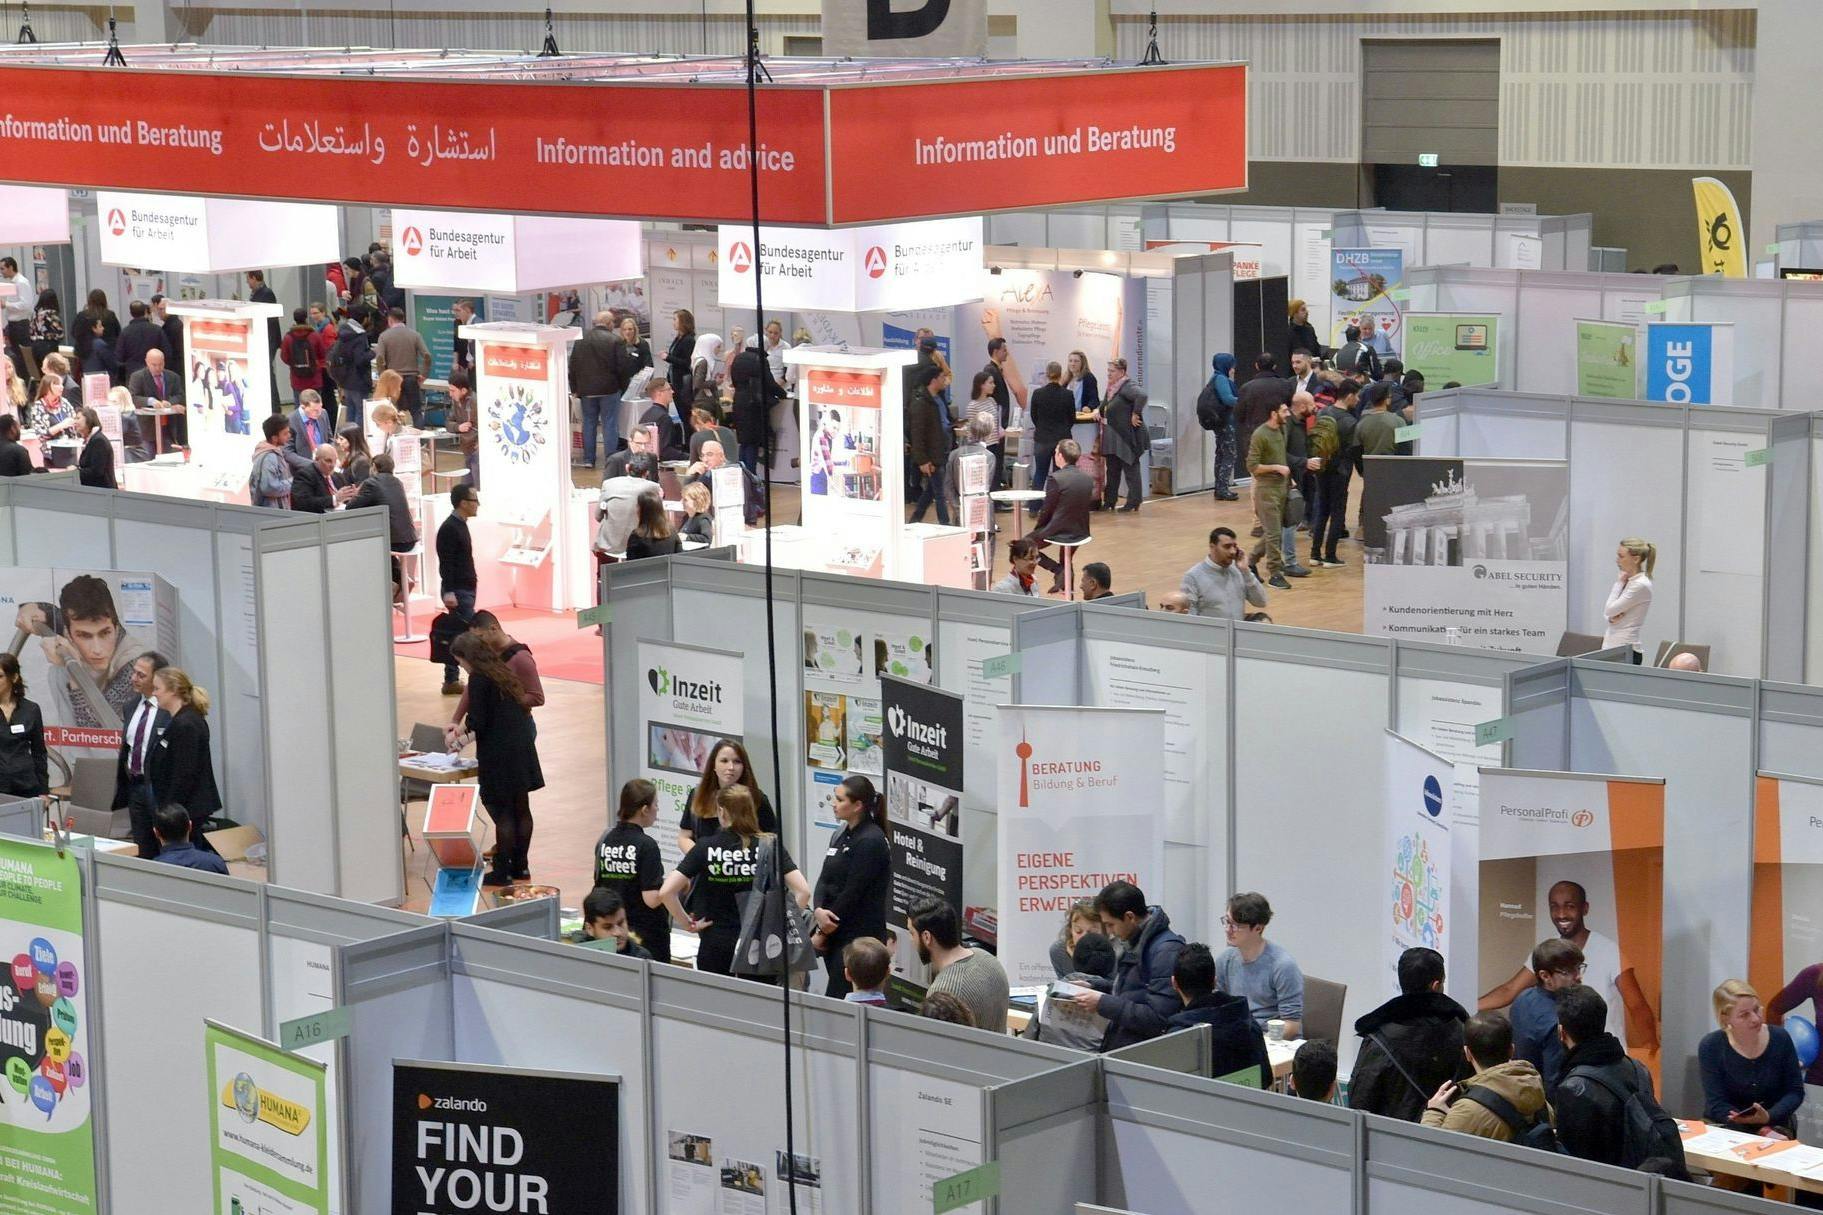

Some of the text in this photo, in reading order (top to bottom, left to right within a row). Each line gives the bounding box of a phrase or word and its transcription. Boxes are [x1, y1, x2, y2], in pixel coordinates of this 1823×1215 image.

[98, 120, 132, 144] und
[137, 120, 223, 155] Beratung
[258, 118, 496, 167] استشارة واستعلامات
[915, 125, 1176, 165] Information und Beratung
[537, 137, 795, 171] Information and advice
[131, 210, 198, 227] Bundesagentur
[132, 226, 174, 240] für Arbeit
[429, 228, 505, 246] Bundesagentur
[430, 245, 477, 260] für Arbeit
[759, 243, 844, 263] Bundesagentur
[1336, 253, 1369, 263] DHZB
[760, 264, 813, 278] für Arbeit
[1488, 572, 1562, 581] ABEL SECURITY
[1388, 605, 1513, 617] Kundenorientierung mit Herz
[1388, 624, 1447, 633] Kommunikati
[1474, 626, 1488, 634] ein
[1489, 628, 1520, 636] starkes
[1522, 628, 1546, 637] Team
[672, 675, 722, 703] Inzeit
[672, 700, 713, 715] Gute Arbeit
[61, 729, 122, 745] Partnersch
[906, 715, 947, 749] Inzeit
[906, 741, 940, 760] Gute Arbeit
[1032, 760, 1101, 775] BERATUNG
[1033, 775, 1119, 790] Bildung & Beruf
[1500, 804, 1569, 819] PersonalProfi
[893, 829, 924, 853] Hotel &
[625, 844, 637, 860] &
[707, 846, 751, 861] Meet
[604, 858, 638, 874] Greet
[906, 852, 947, 882] Reinigung
[1017, 852, 1075, 869] EIGENE
[33, 876, 64, 892] PEOPLE
[294, 1021, 321, 1042] A16
[434, 1096, 487, 1112] zalando
[918, 1091, 943, 1104] Zalando
[259, 1095, 301, 1122] HUMANA
[417, 1120, 524, 1166] FIND
[415, 1165, 549, 1215] YOUR
[946, 1179, 971, 1201] A17
